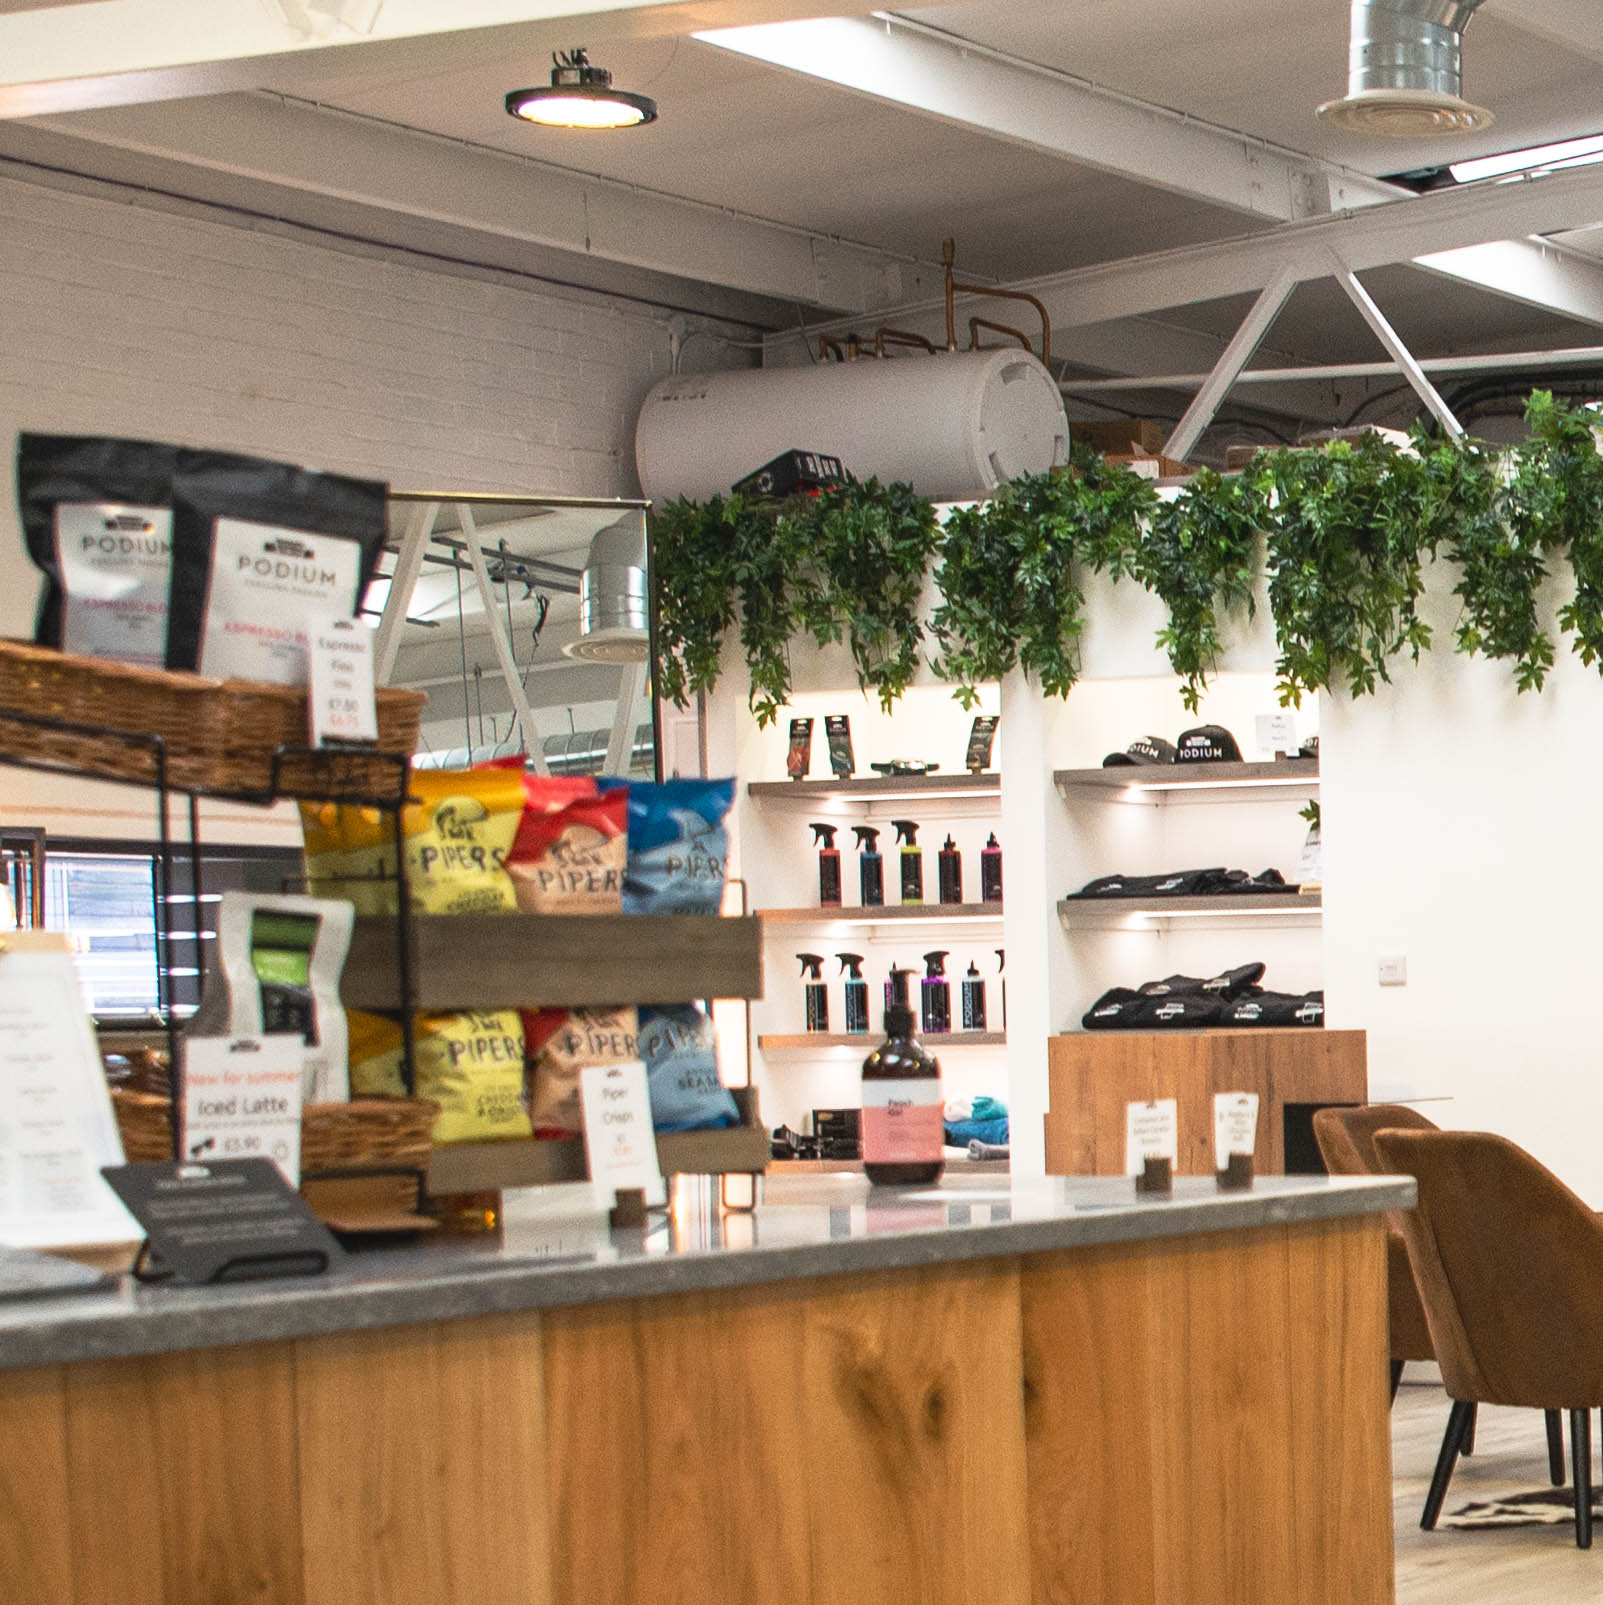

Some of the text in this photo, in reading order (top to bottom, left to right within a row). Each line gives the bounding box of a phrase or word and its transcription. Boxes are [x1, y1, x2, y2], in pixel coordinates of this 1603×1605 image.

[237, 554, 337, 587] PODIUM
[1180, 748, 1222, 760] PODIUM
[421, 846, 505, 874] PIPERS
[198, 1096, 289, 1116] Iced Latte
